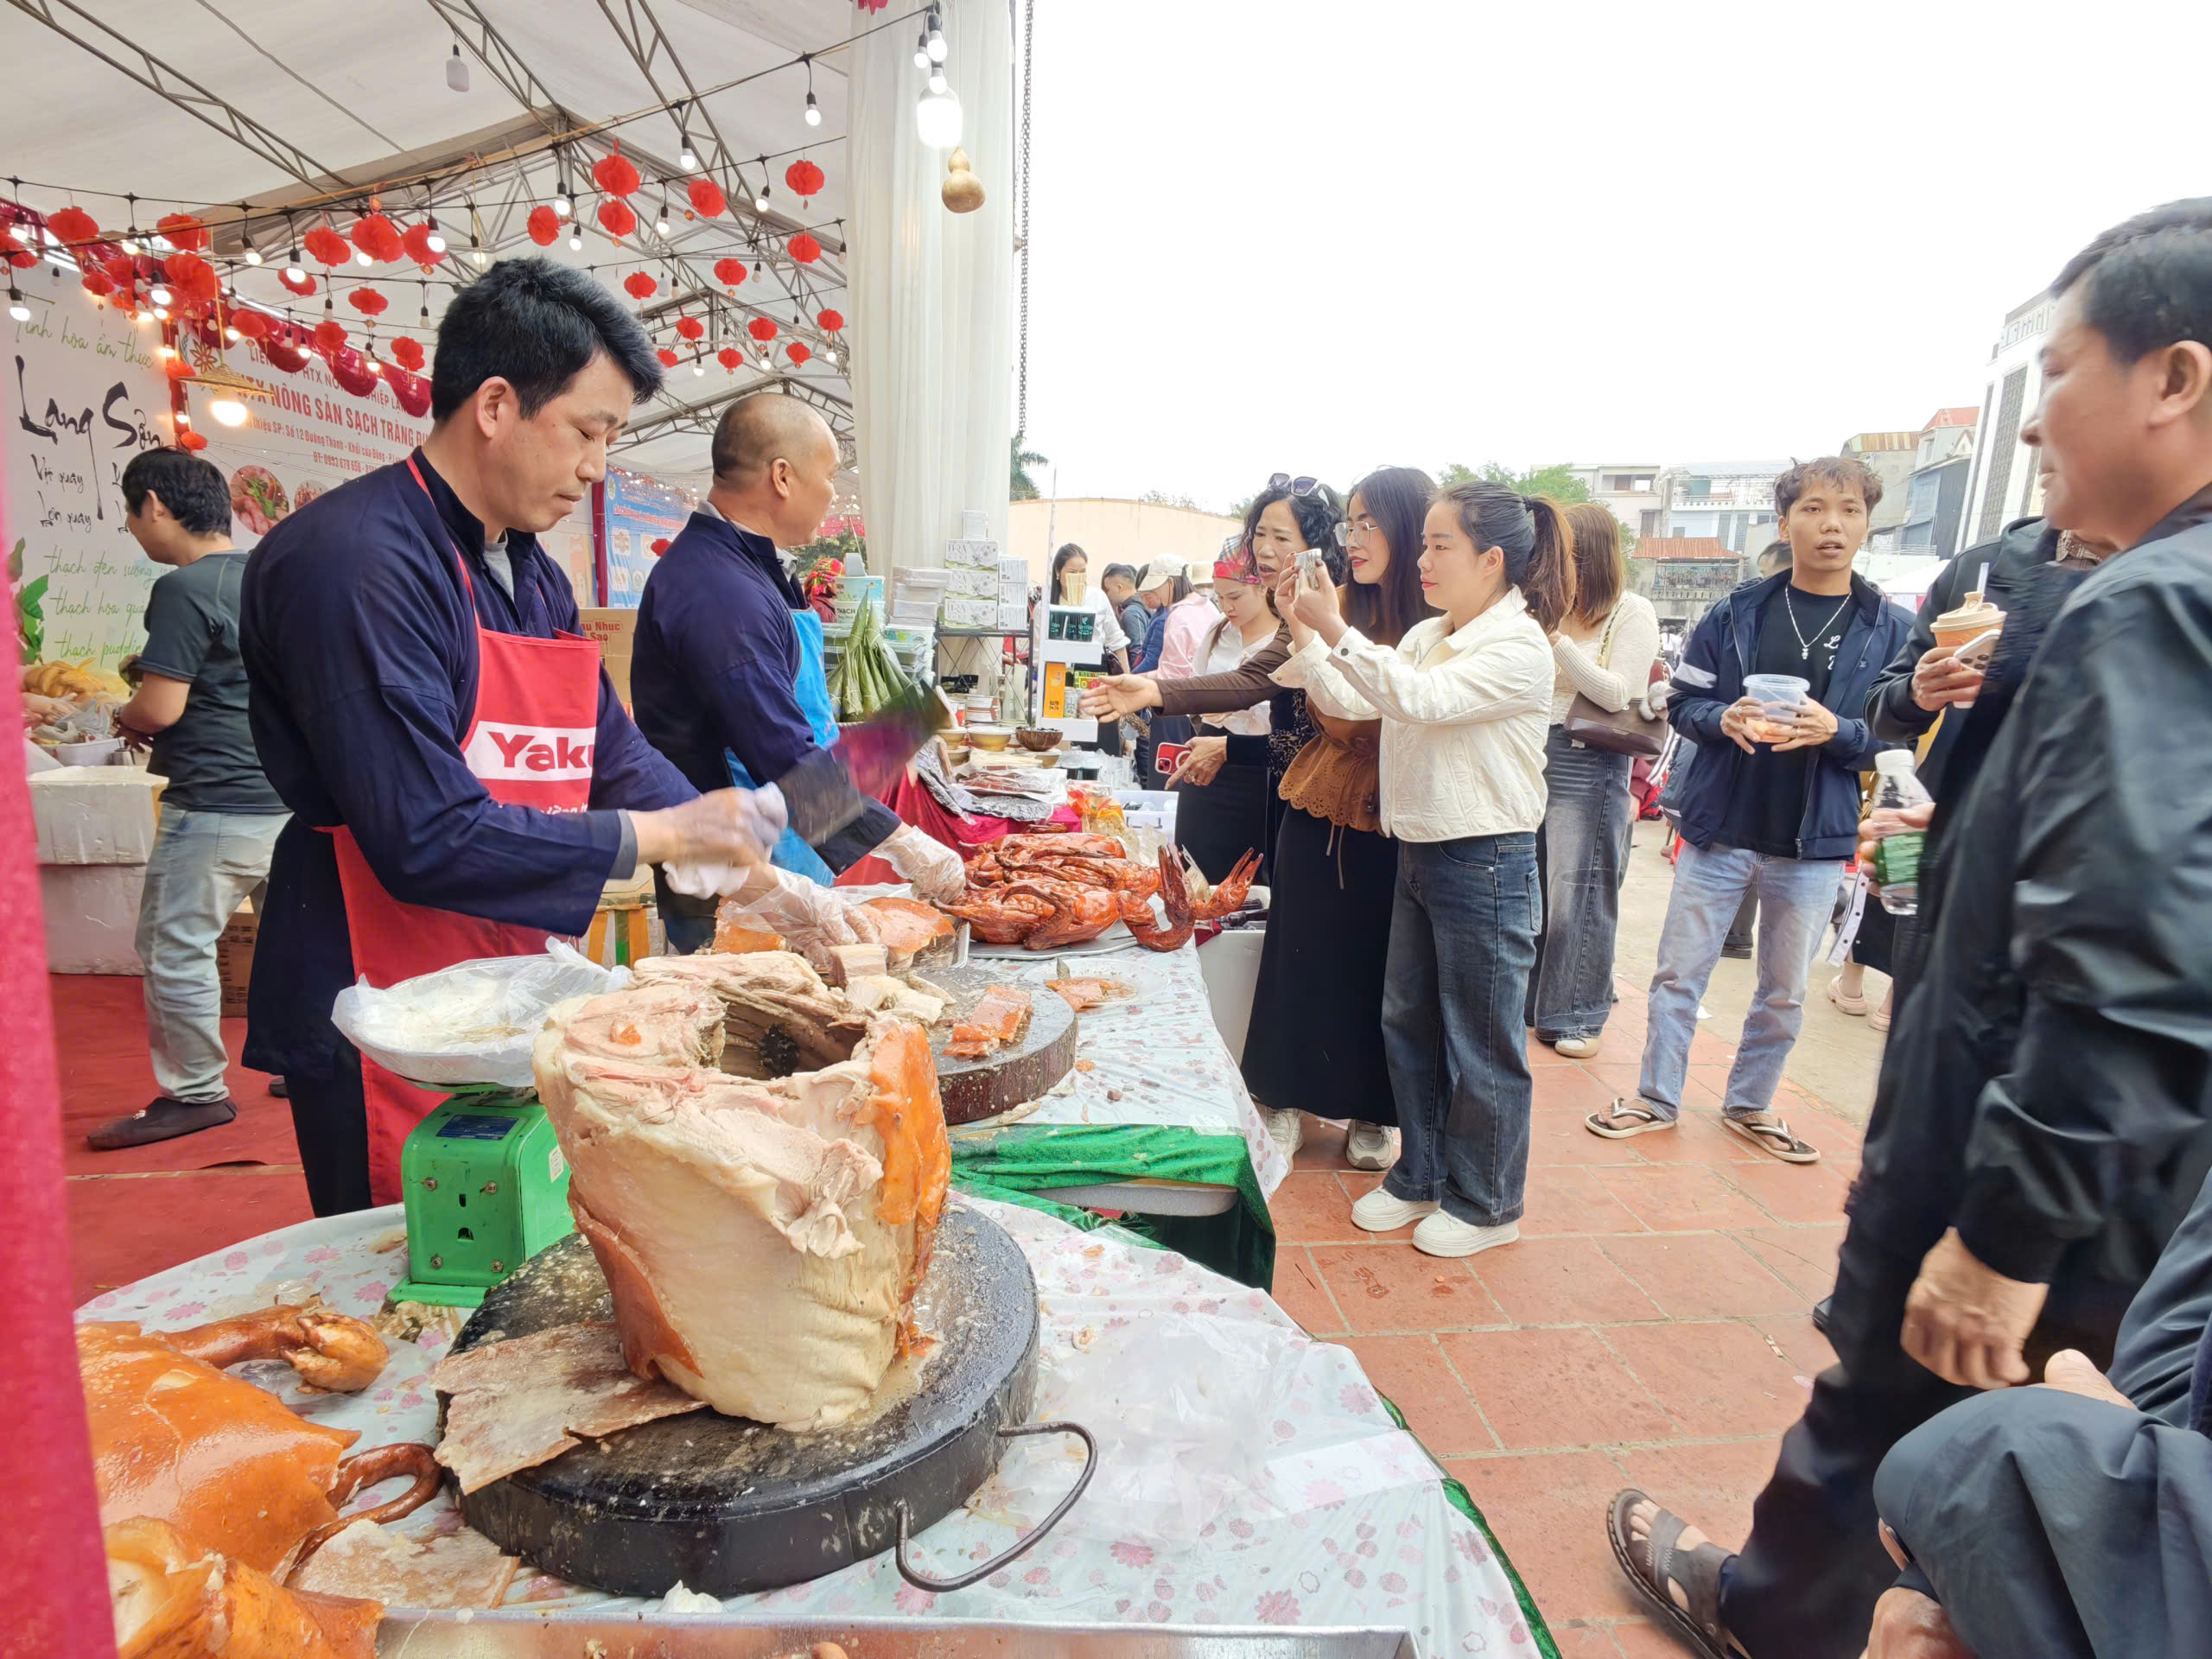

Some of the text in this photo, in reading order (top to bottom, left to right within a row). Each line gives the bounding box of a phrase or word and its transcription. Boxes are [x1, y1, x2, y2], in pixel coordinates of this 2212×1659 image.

[269, 381, 312, 417] NÔNG
[315, 393, 343, 426] SẢN
[346, 407, 378, 436] SẠCH
[379, 416, 415, 447] TRÀNG
